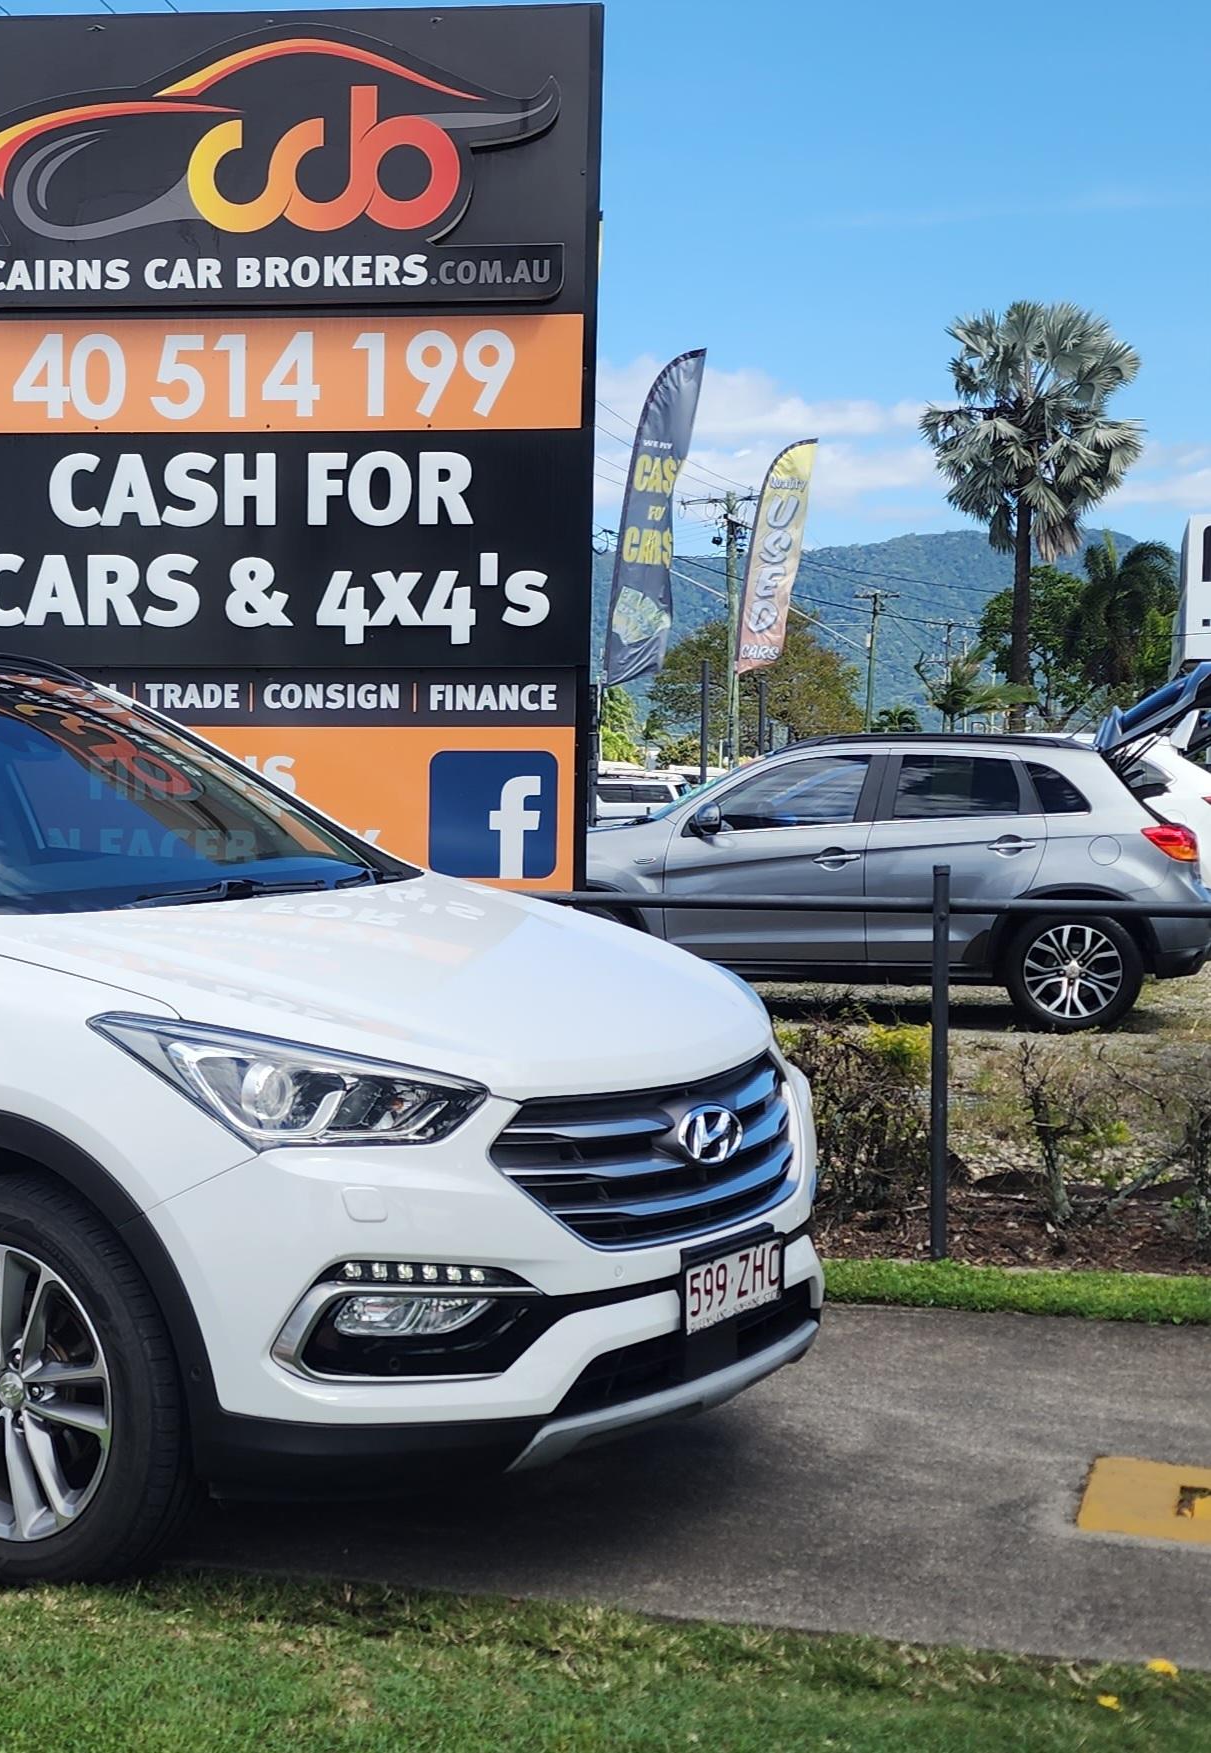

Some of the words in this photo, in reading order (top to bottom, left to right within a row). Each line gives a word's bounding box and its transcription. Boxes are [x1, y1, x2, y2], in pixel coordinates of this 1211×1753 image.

[144, 258, 222, 290] CAR
[12, 333, 127, 421] 40
[149, 331, 320, 420] 514
[352, 329, 516, 418] 199
[48, 451, 277, 528] CASH
[307, 450, 474, 527] FOR
[224, 556, 294, 628] &
[747, 494, 800, 634] USED
[740, 645, 780, 661] CARS
[145, 683, 240, 710] TRADE
[263, 682, 401, 710] CONSIGN
[429, 683, 558, 711] FINANCE
[690, 1263, 727, 1317] 599
